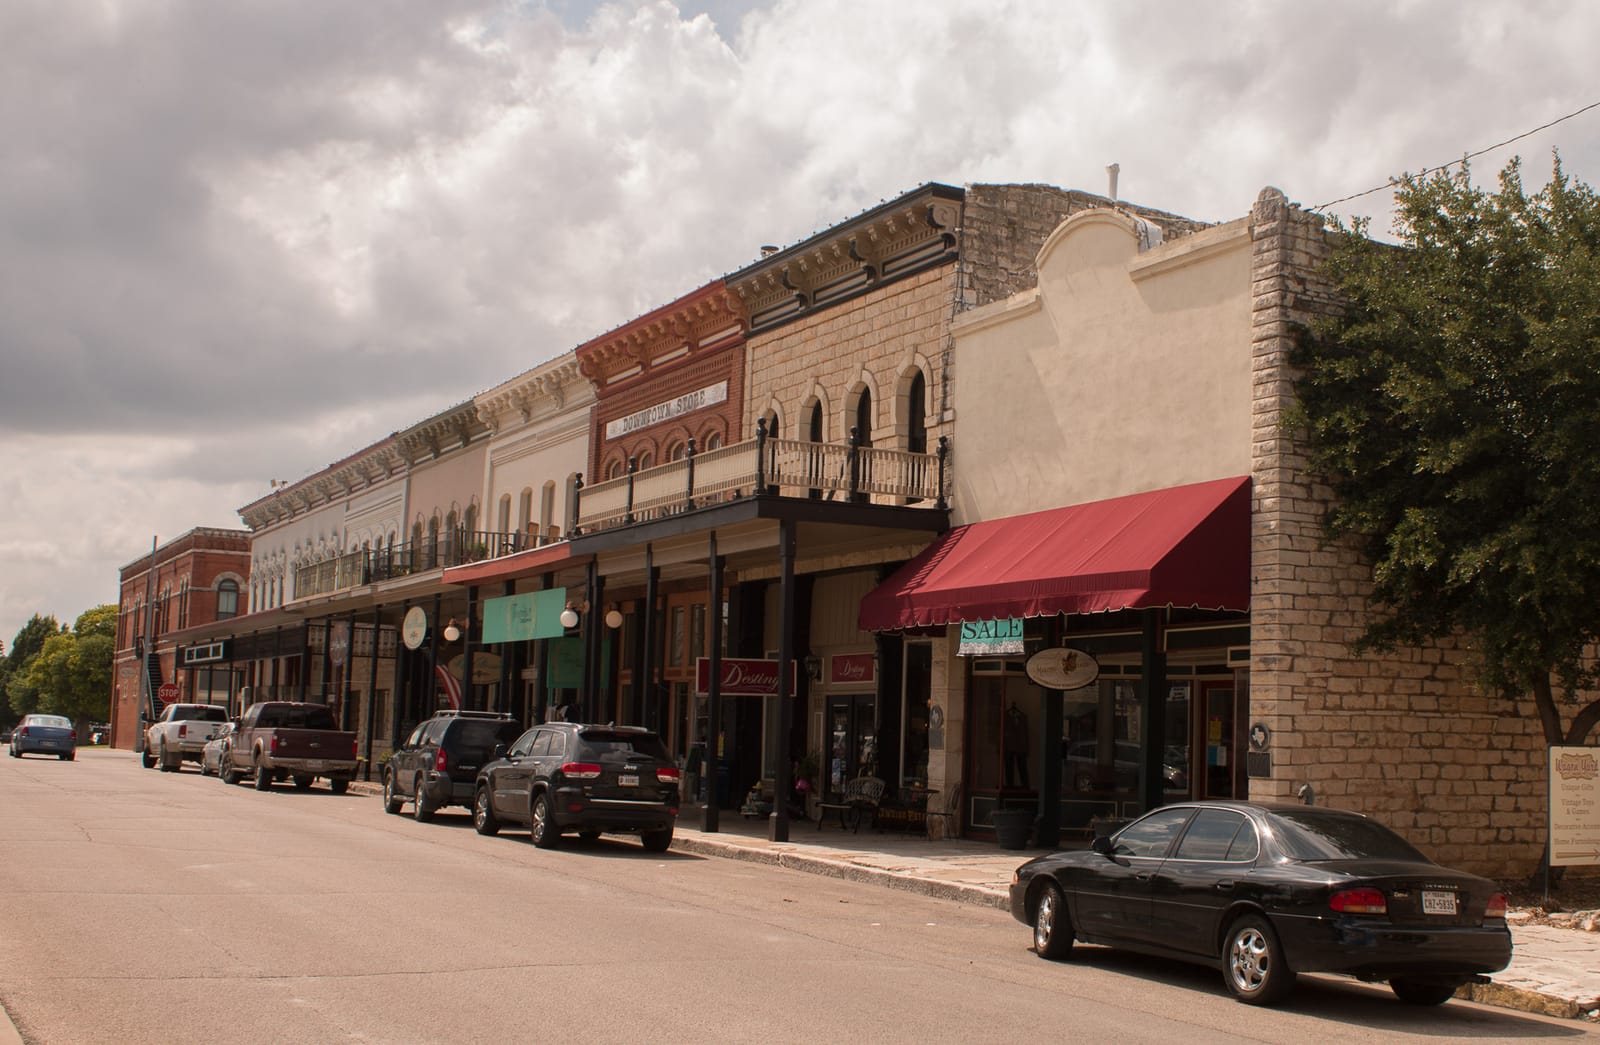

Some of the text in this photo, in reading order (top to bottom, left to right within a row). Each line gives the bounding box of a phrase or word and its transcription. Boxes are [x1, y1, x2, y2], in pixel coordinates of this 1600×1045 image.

[622, 390, 705, 432] DOWNTOWN STORE
[962, 618, 1022, 639] SALE
[720, 662, 780, 690] Destiny
[160, 688, 179, 698] STOP
